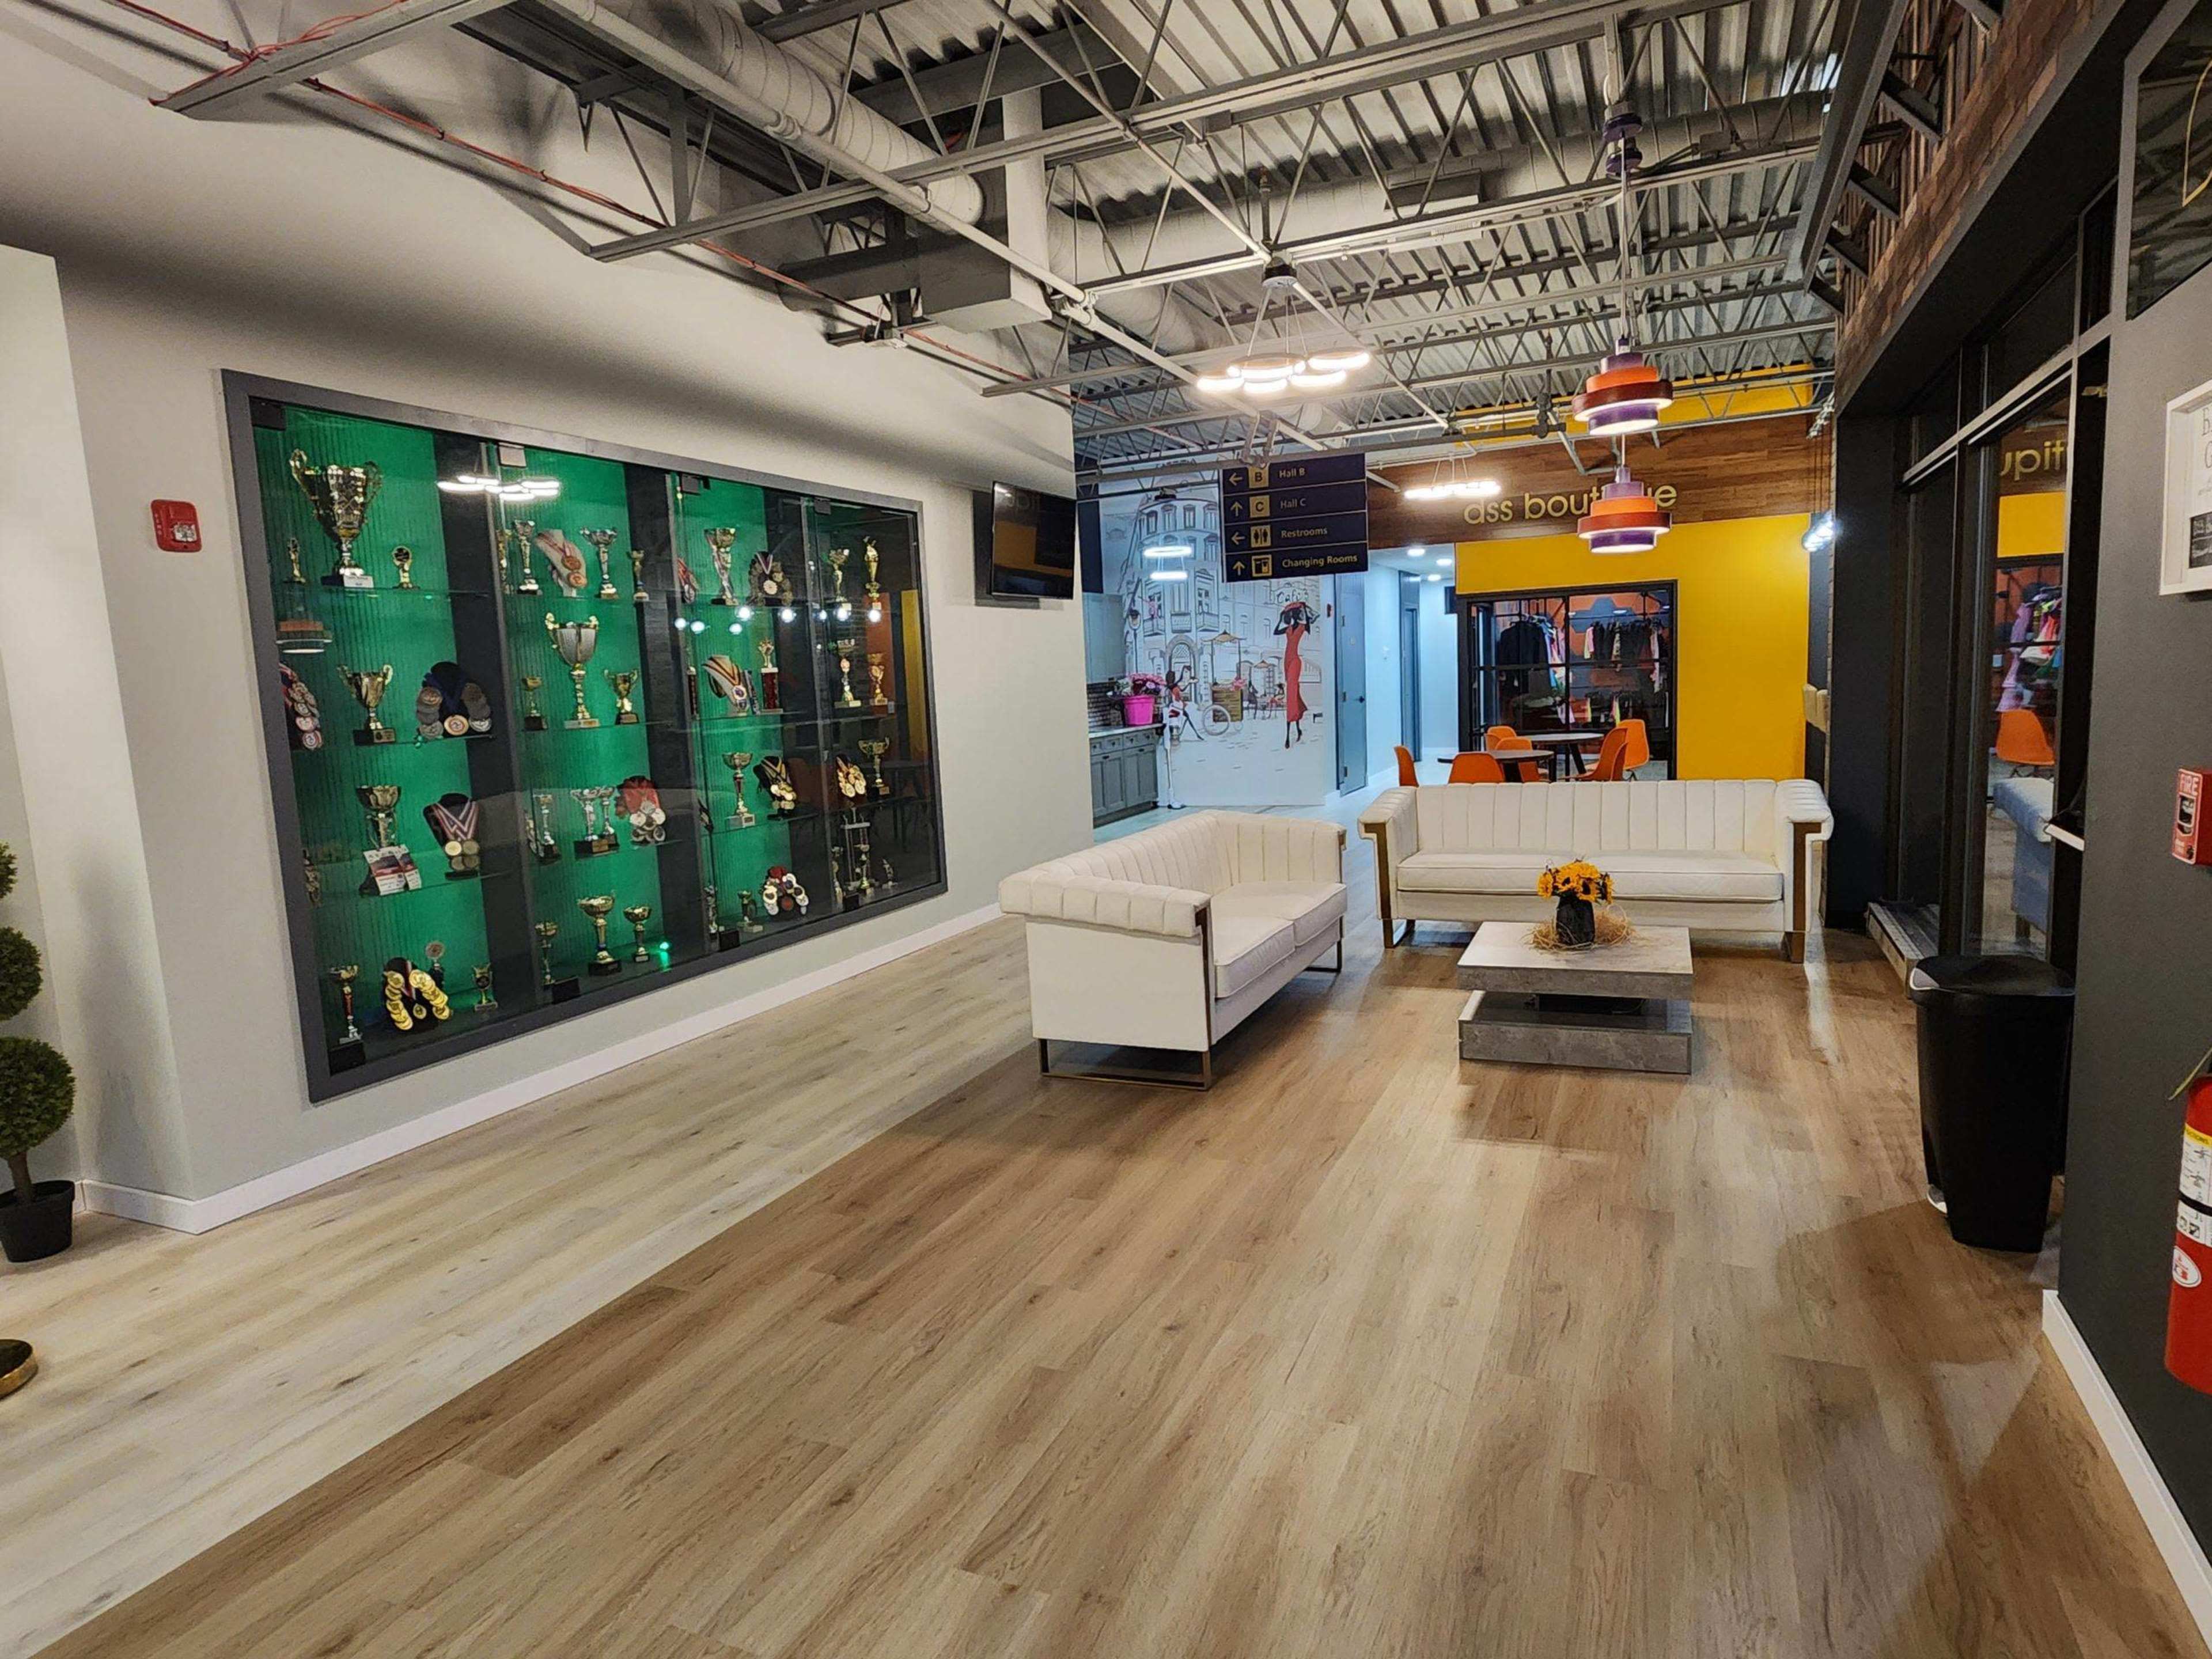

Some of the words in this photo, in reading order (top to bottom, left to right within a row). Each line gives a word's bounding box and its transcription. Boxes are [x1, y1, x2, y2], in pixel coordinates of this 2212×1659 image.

[1255, 471, 1263, 482] B
[1279, 468, 1297, 479] Hall
[1299, 467, 1305, 476] B
[1256, 501, 1264, 512] C
[1280, 498, 1298, 509] Hall
[1300, 497, 1306, 506] C
[1525, 484, 1677, 520] boute
[1281, 527, 1328, 539] Restrooms
[1282, 556, 1325, 568] Changing
[1327, 554, 1358, 564] Rooms
